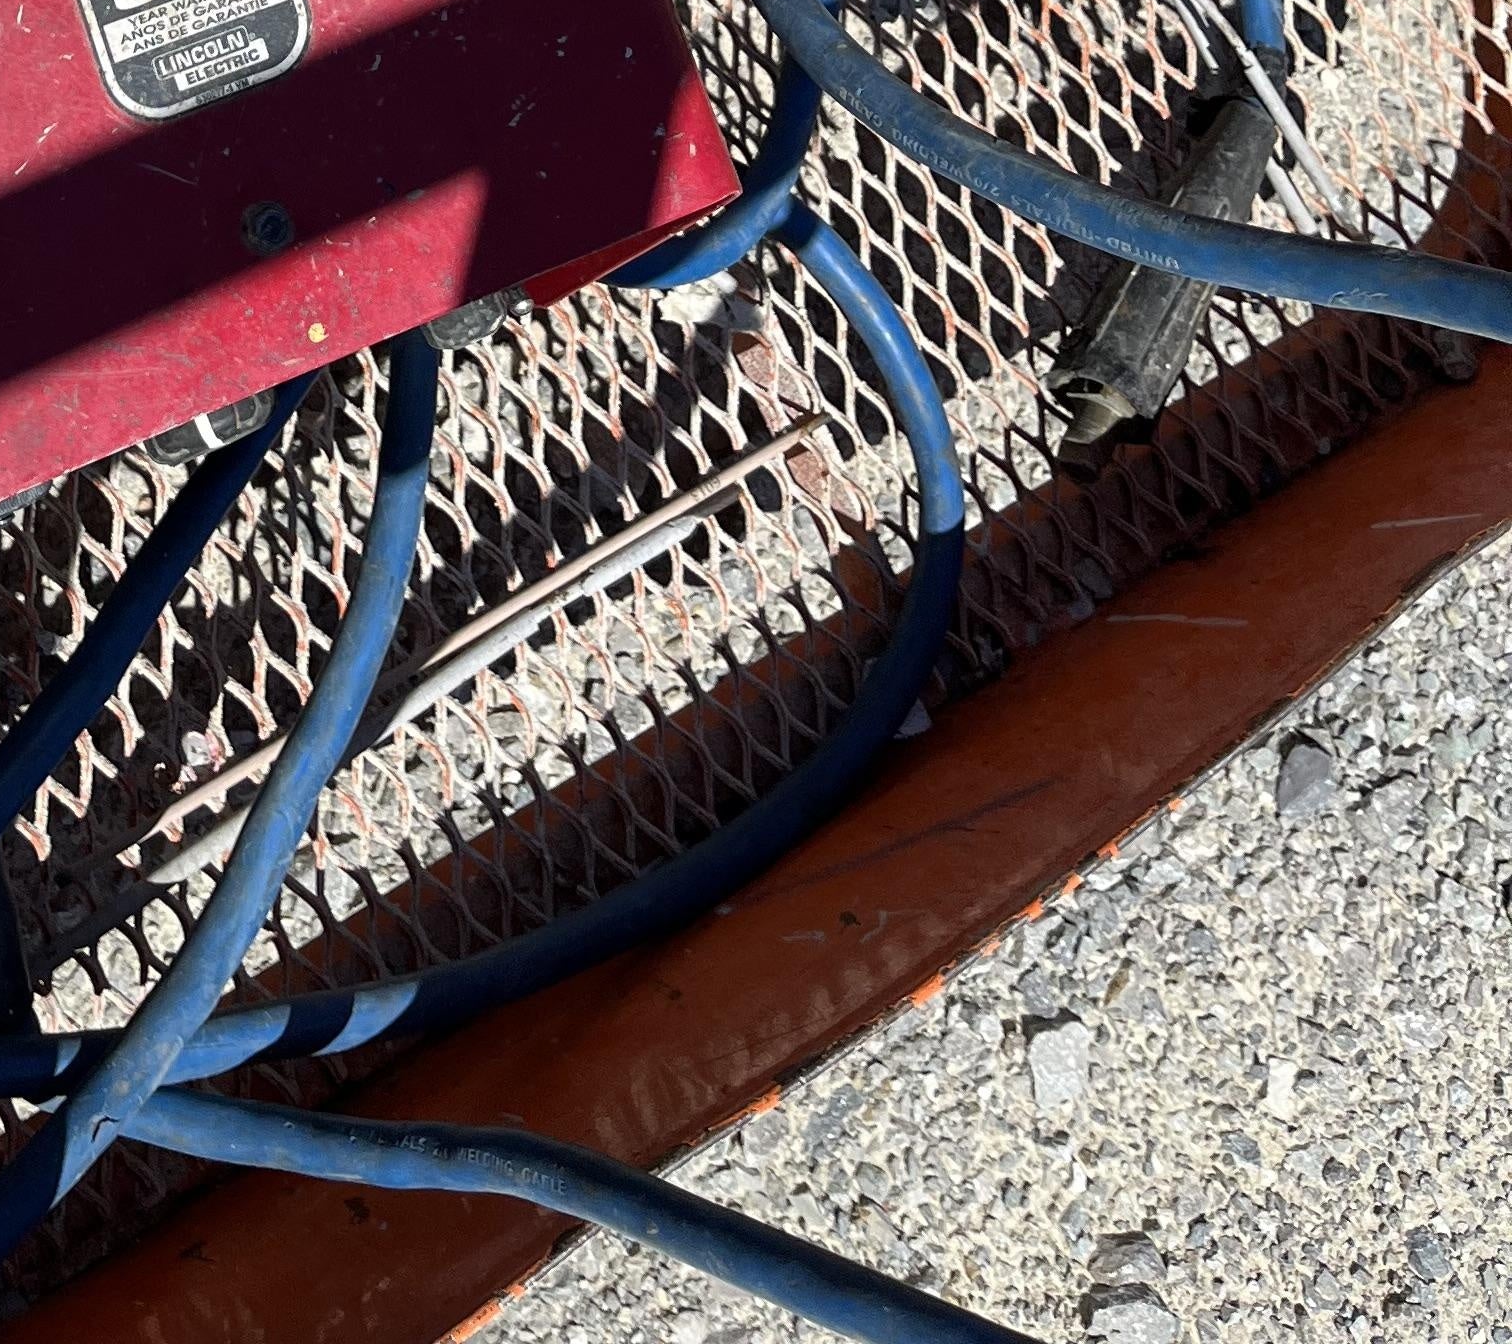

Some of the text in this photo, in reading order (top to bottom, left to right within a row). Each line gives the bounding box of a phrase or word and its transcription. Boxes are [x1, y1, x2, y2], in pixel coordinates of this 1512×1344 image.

[128, 6, 169, 29] YEAR
[169, 12, 190, 27] DE
[132, 33, 165, 53] ANS
[168, 24, 188, 39] DE
[158, 29, 247, 76] LINCOLN
[186, 48, 260, 84] ELECTRIC
